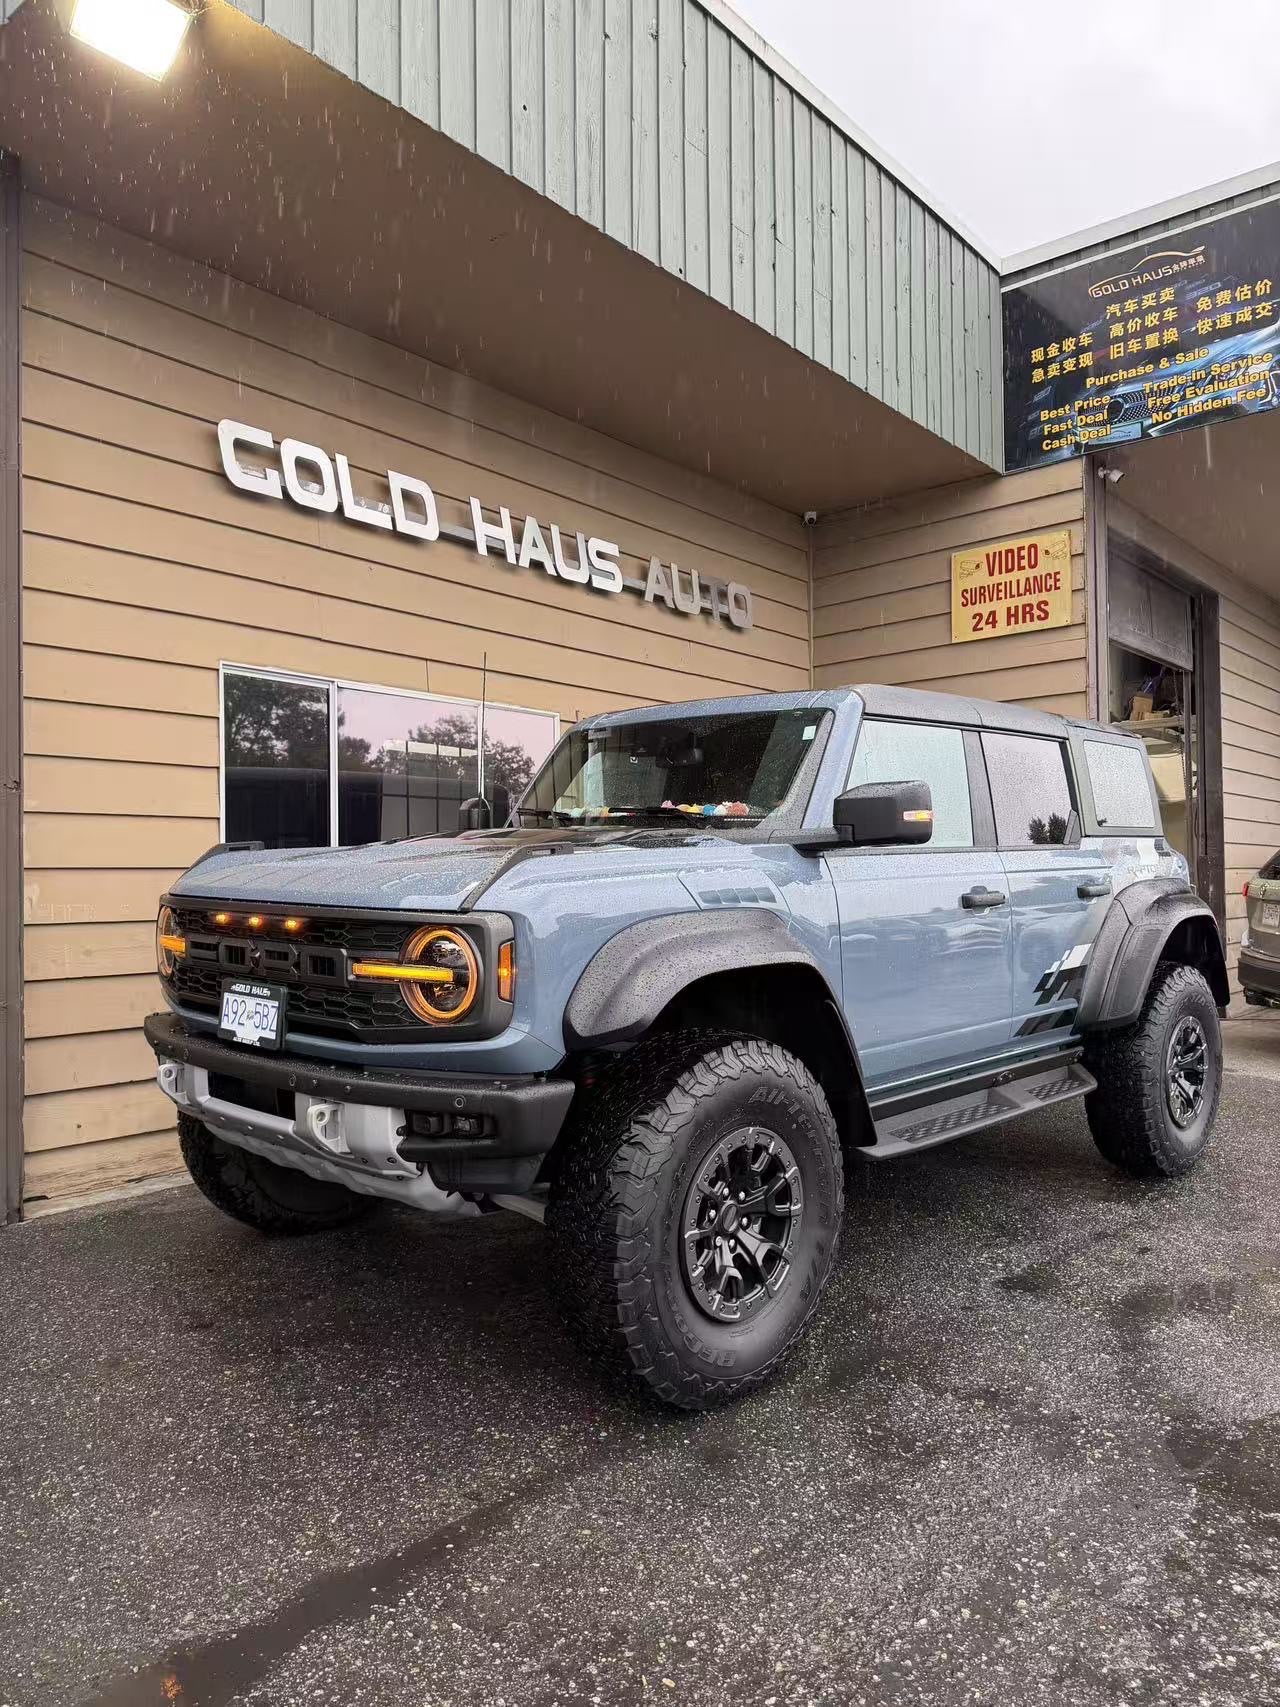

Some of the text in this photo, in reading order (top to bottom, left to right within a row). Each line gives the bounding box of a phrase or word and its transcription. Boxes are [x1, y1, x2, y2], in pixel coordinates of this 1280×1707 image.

[1091, 280, 1129, 298] GOLD
[1131, 265, 1173, 286] HAUS
[1195, 279, 1273, 313] 免费估价
[1105, 287, 1176, 320] 汽车买卖
[1196, 302, 1274, 335] 快速成交
[1109, 306, 1179, 339] 高价收车
[1031, 331, 1094, 364] 现金收车
[1109, 327, 1179, 360] 旧车置换
[1031, 352, 1094, 384] 急卖变现
[1086, 347, 1209, 389] Purchase & Sale
[1143, 352, 1273, 394] Trade-in Service
[1148, 369, 1270, 409] Free Evaluation
[1152, 387, 1267, 424] No Hidden Fee
[1040, 395, 1111, 421] Best Price
[1043, 409, 1108, 436] Fast Deal
[1042, 433, 1076, 451] Cash
[1080, 424, 1111, 442] Deal
[217, 418, 754, 629] GOLD HAUS AUTO
[985, 543, 1039, 577] VIDEO
[961, 571, 1061, 608] SURVEILLANCE
[972, 600, 1050, 632] 24 HRS
[223, 997, 279, 1032] A92 5BZ
